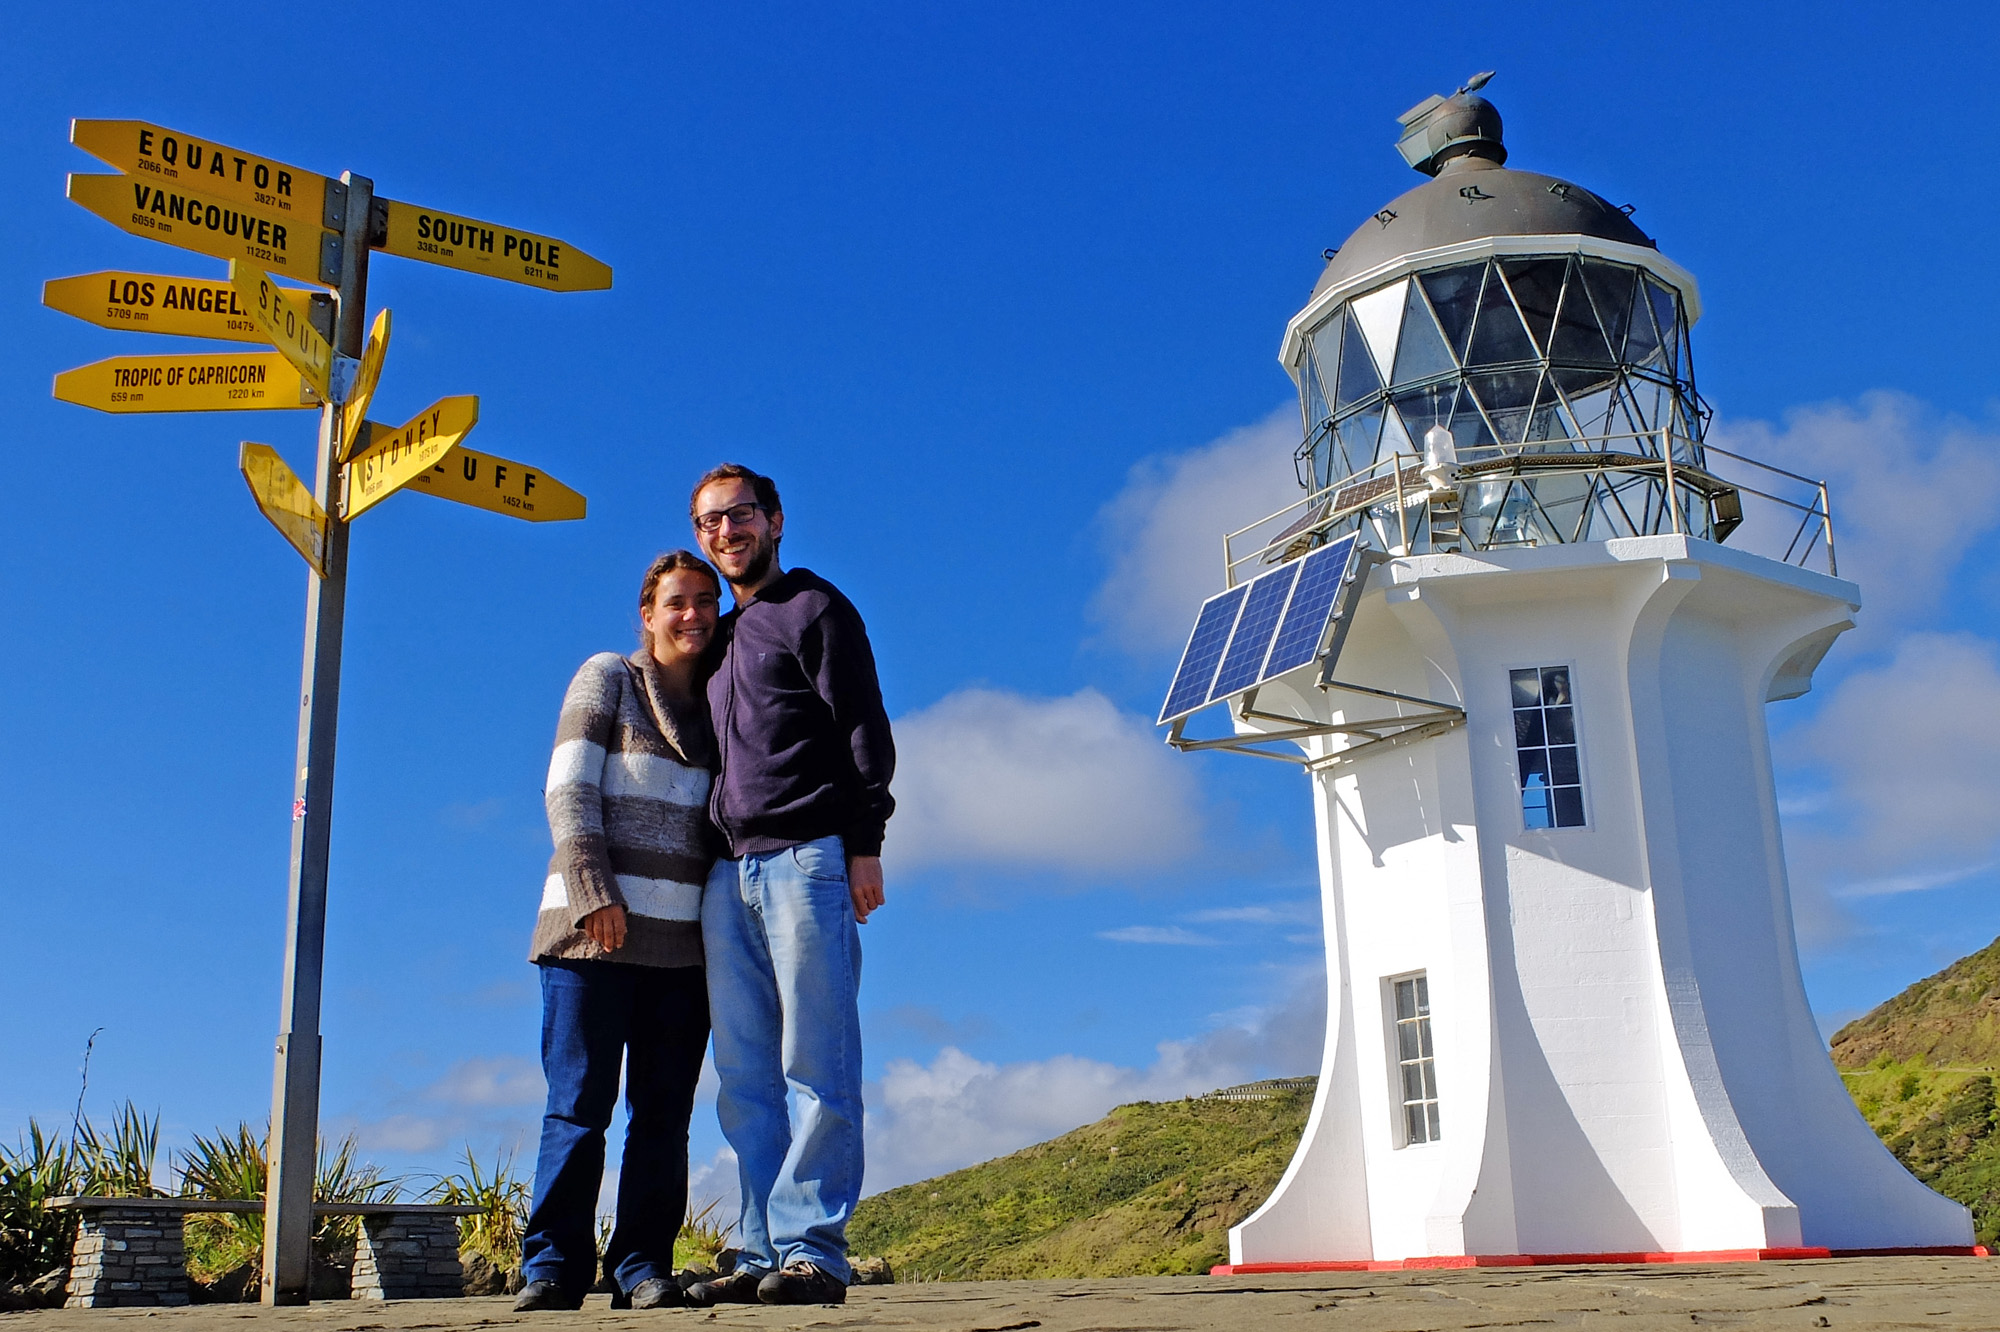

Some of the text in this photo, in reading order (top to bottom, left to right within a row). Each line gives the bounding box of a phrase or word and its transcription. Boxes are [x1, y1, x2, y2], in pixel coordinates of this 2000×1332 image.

[137, 158, 178, 179] 2066 nm
[139, 129, 292, 197] EQUATOR
[254, 191, 292, 211] 3827 km
[131, 213, 172, 233] 6059 nm
[134, 182, 288, 250] VANCOUVER
[417, 214, 560, 268] SOUTH POLE
[246, 246, 287, 265] 11222 km
[440, 247, 454, 257] nm
[524, 265, 559, 282] 6211 km
[108, 279, 248, 316] LOS ANGEL
[107, 307, 149, 322] 5709 nm
[258, 280, 319, 368] SEOUL
[226, 319, 255, 332] 10479
[114, 364, 266, 387] TROPIC OF CAPRICORN
[111, 391, 144, 402] 659 nm
[228, 388, 265, 400] 1220 km
[366, 410, 440, 482] SYDNEY
[502, 495, 534, 512] 1452 km
